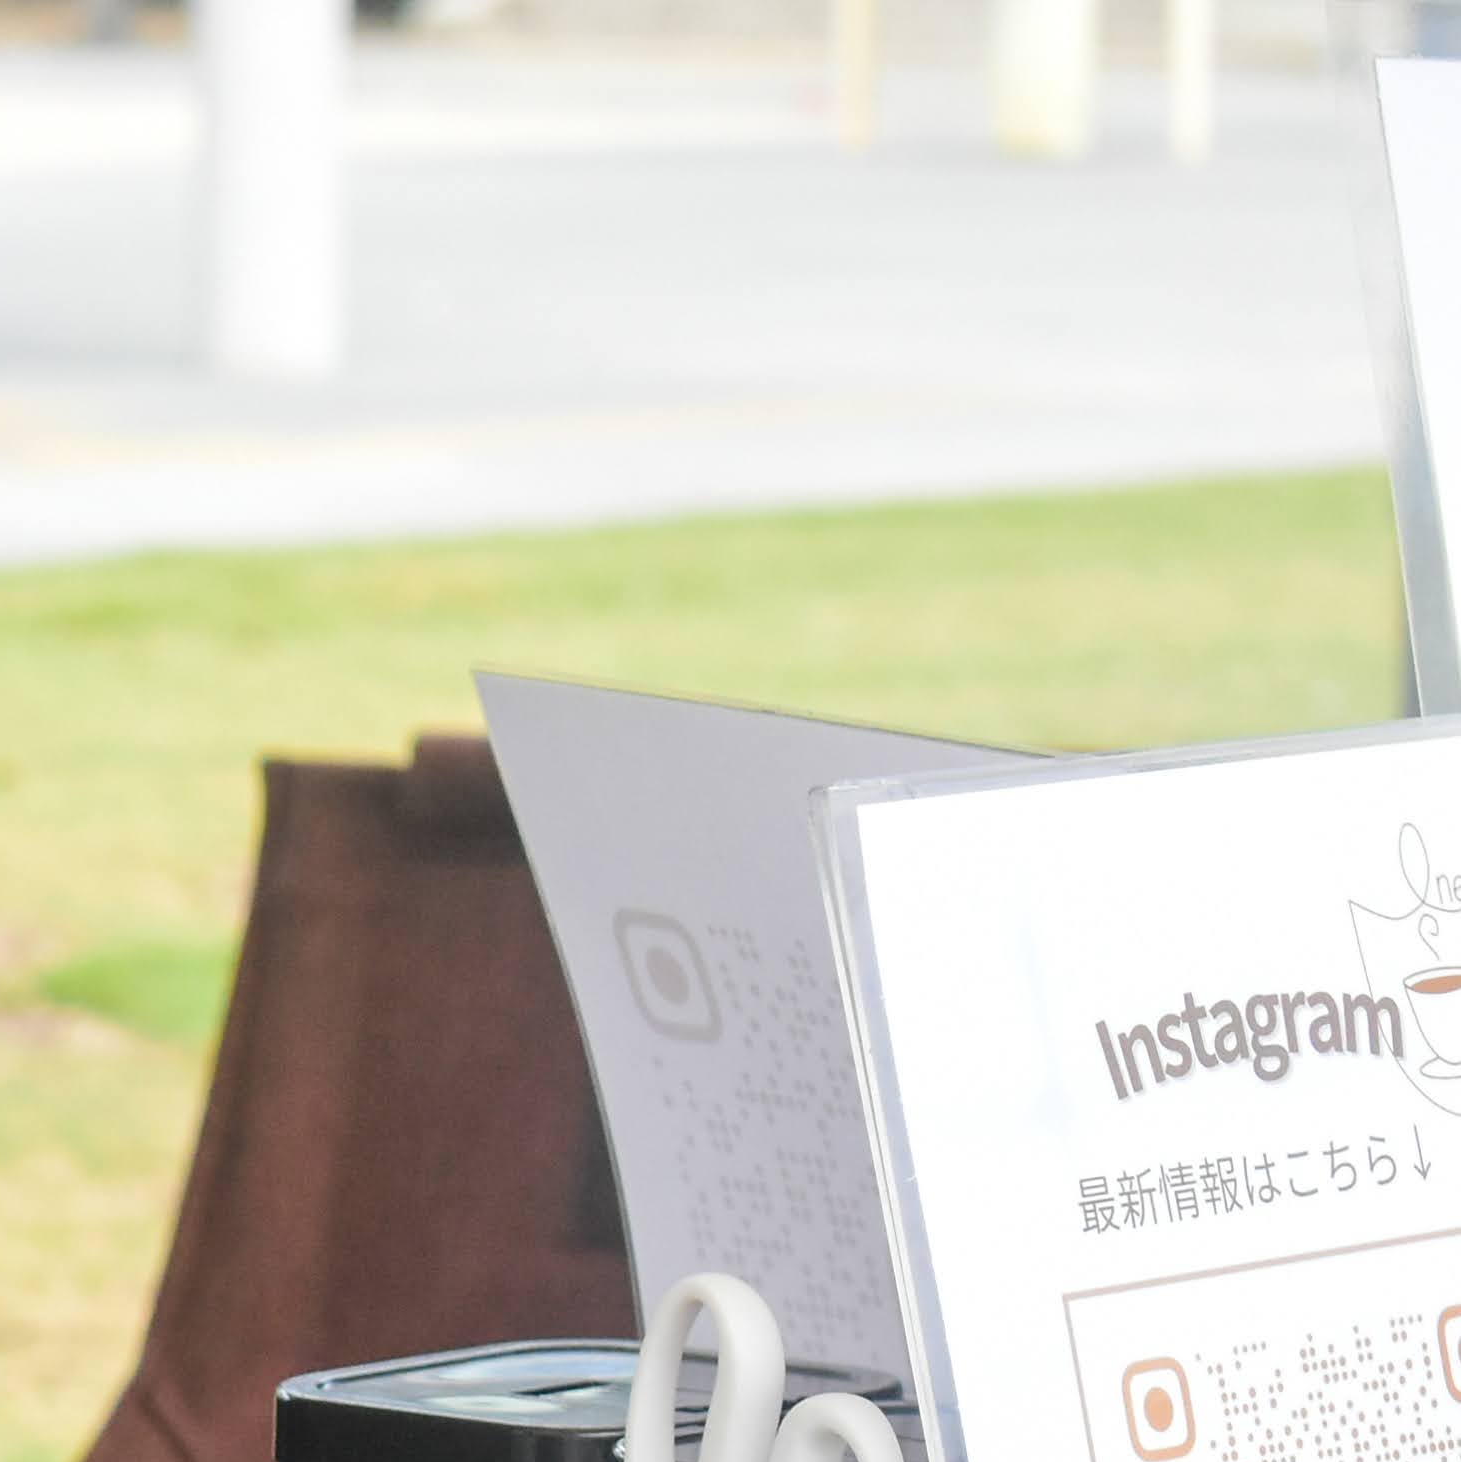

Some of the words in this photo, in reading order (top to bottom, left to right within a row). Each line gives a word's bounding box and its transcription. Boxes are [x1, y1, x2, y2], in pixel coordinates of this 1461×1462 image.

[1095, 991, 1405, 1101] Instagram
[1078, 1135, 1398, 1235] 最新情報はこちら
